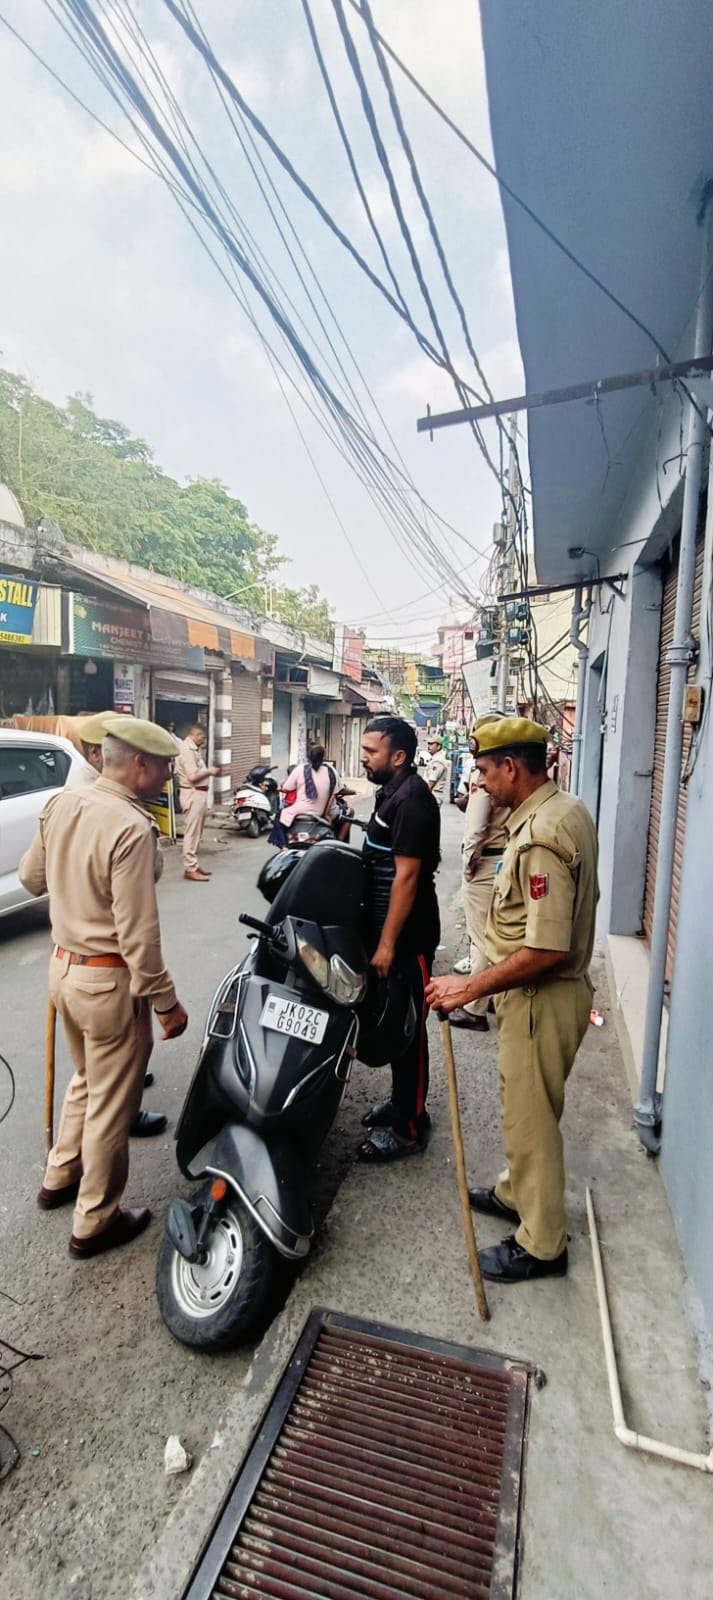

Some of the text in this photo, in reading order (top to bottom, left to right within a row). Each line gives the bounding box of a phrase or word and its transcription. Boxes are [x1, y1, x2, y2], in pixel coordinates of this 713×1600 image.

[0, 578, 33, 608] STALL
[92, 621, 143, 640] MANJEET
[280, 1002, 322, 1025] JK02C
[277, 1016, 318, 1040] G9049
